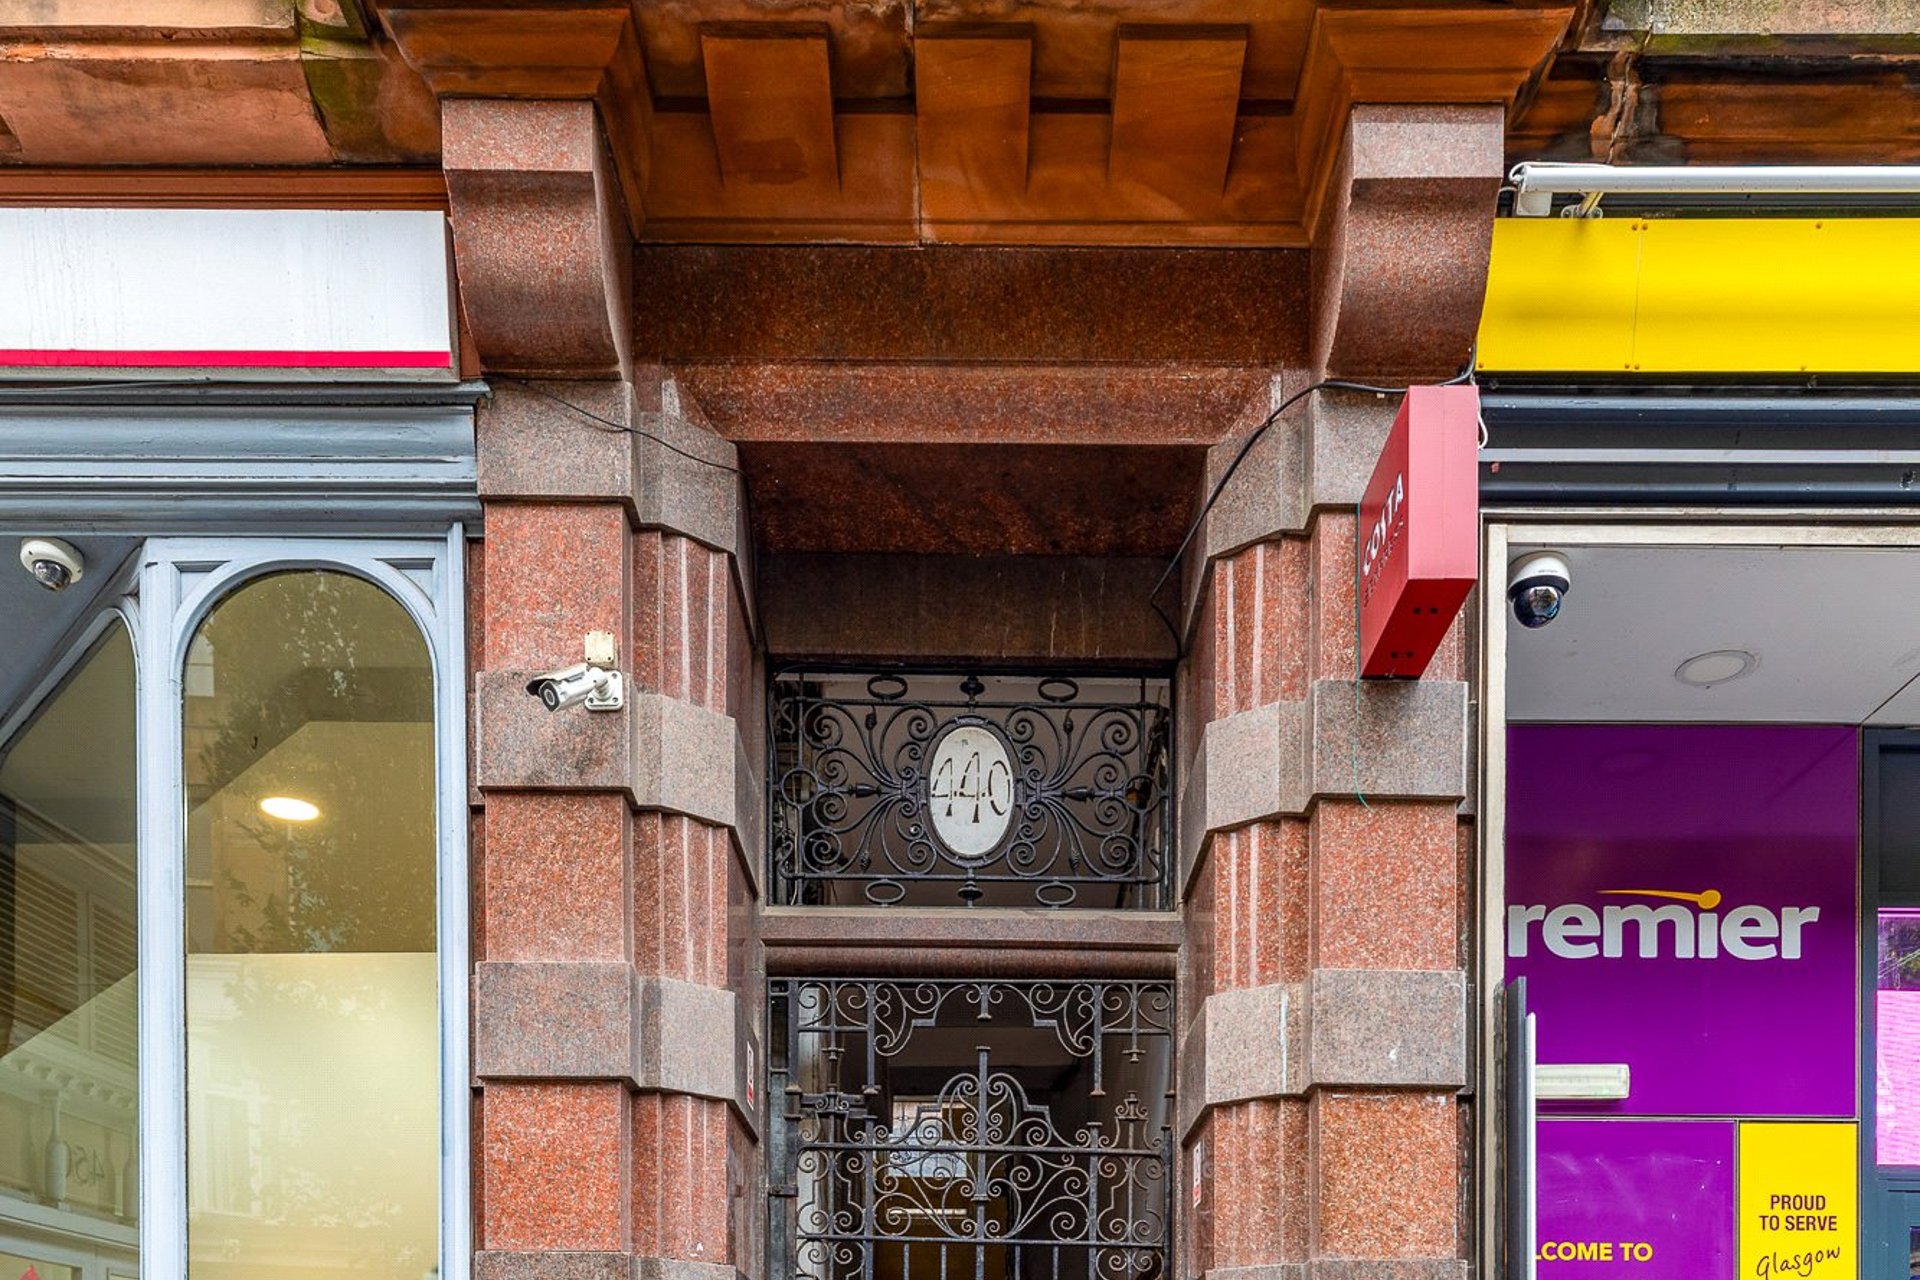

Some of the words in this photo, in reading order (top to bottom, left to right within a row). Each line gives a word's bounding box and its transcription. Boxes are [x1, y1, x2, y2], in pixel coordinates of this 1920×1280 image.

[1363, 472, 1404, 576] COSTA
[931, 751, 1011, 823] 440
[1770, 1194, 1826, 1211] PROUD
[1758, 1215, 1780, 1231] TO
[1785, 1215, 1837, 1231] SERVE
[1619, 1241, 1653, 1261] TO
[1756, 1246, 1840, 1280] Glasgow
